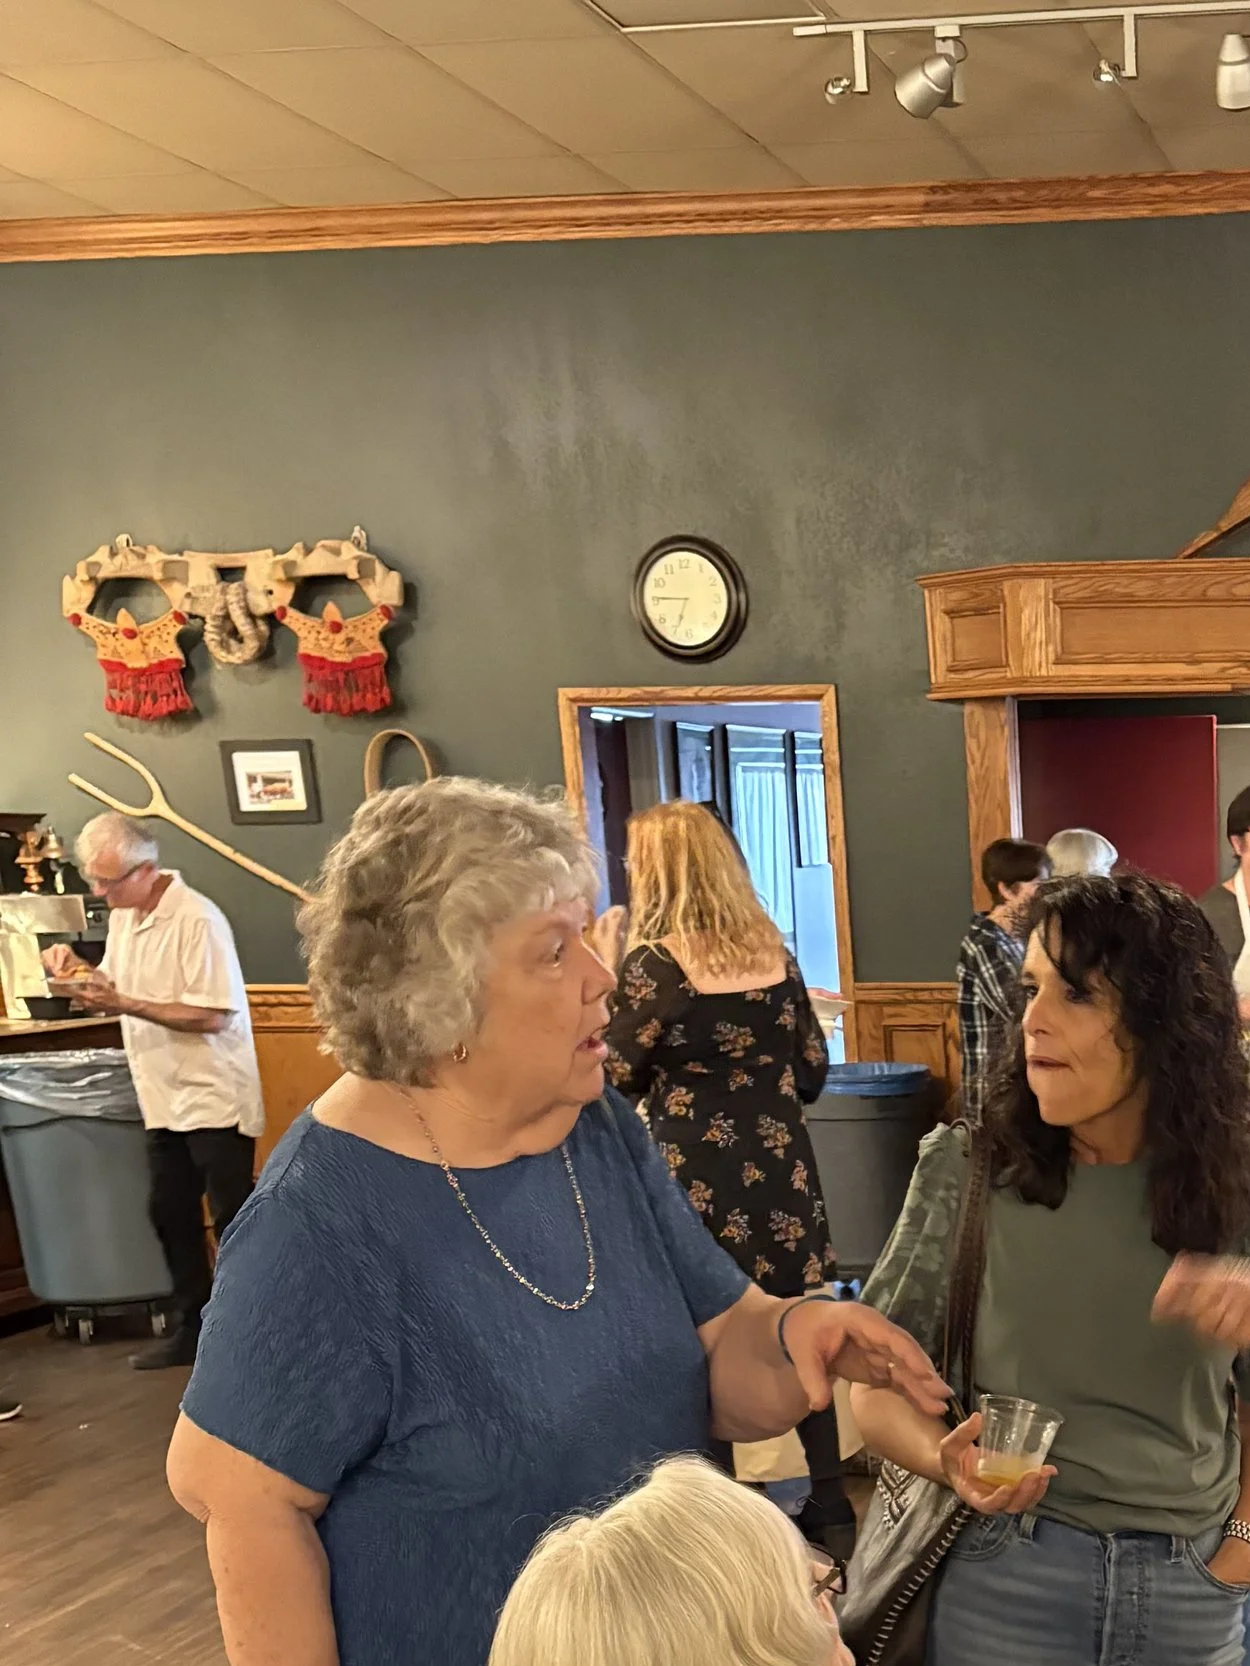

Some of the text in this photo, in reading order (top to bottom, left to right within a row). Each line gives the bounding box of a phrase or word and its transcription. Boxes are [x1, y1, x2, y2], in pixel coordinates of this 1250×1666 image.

[664, 563, 674, 575] 11
[679, 558, 691, 570] 12
[653, 577, 666, 589] 10
[709, 577, 718, 587] 2
